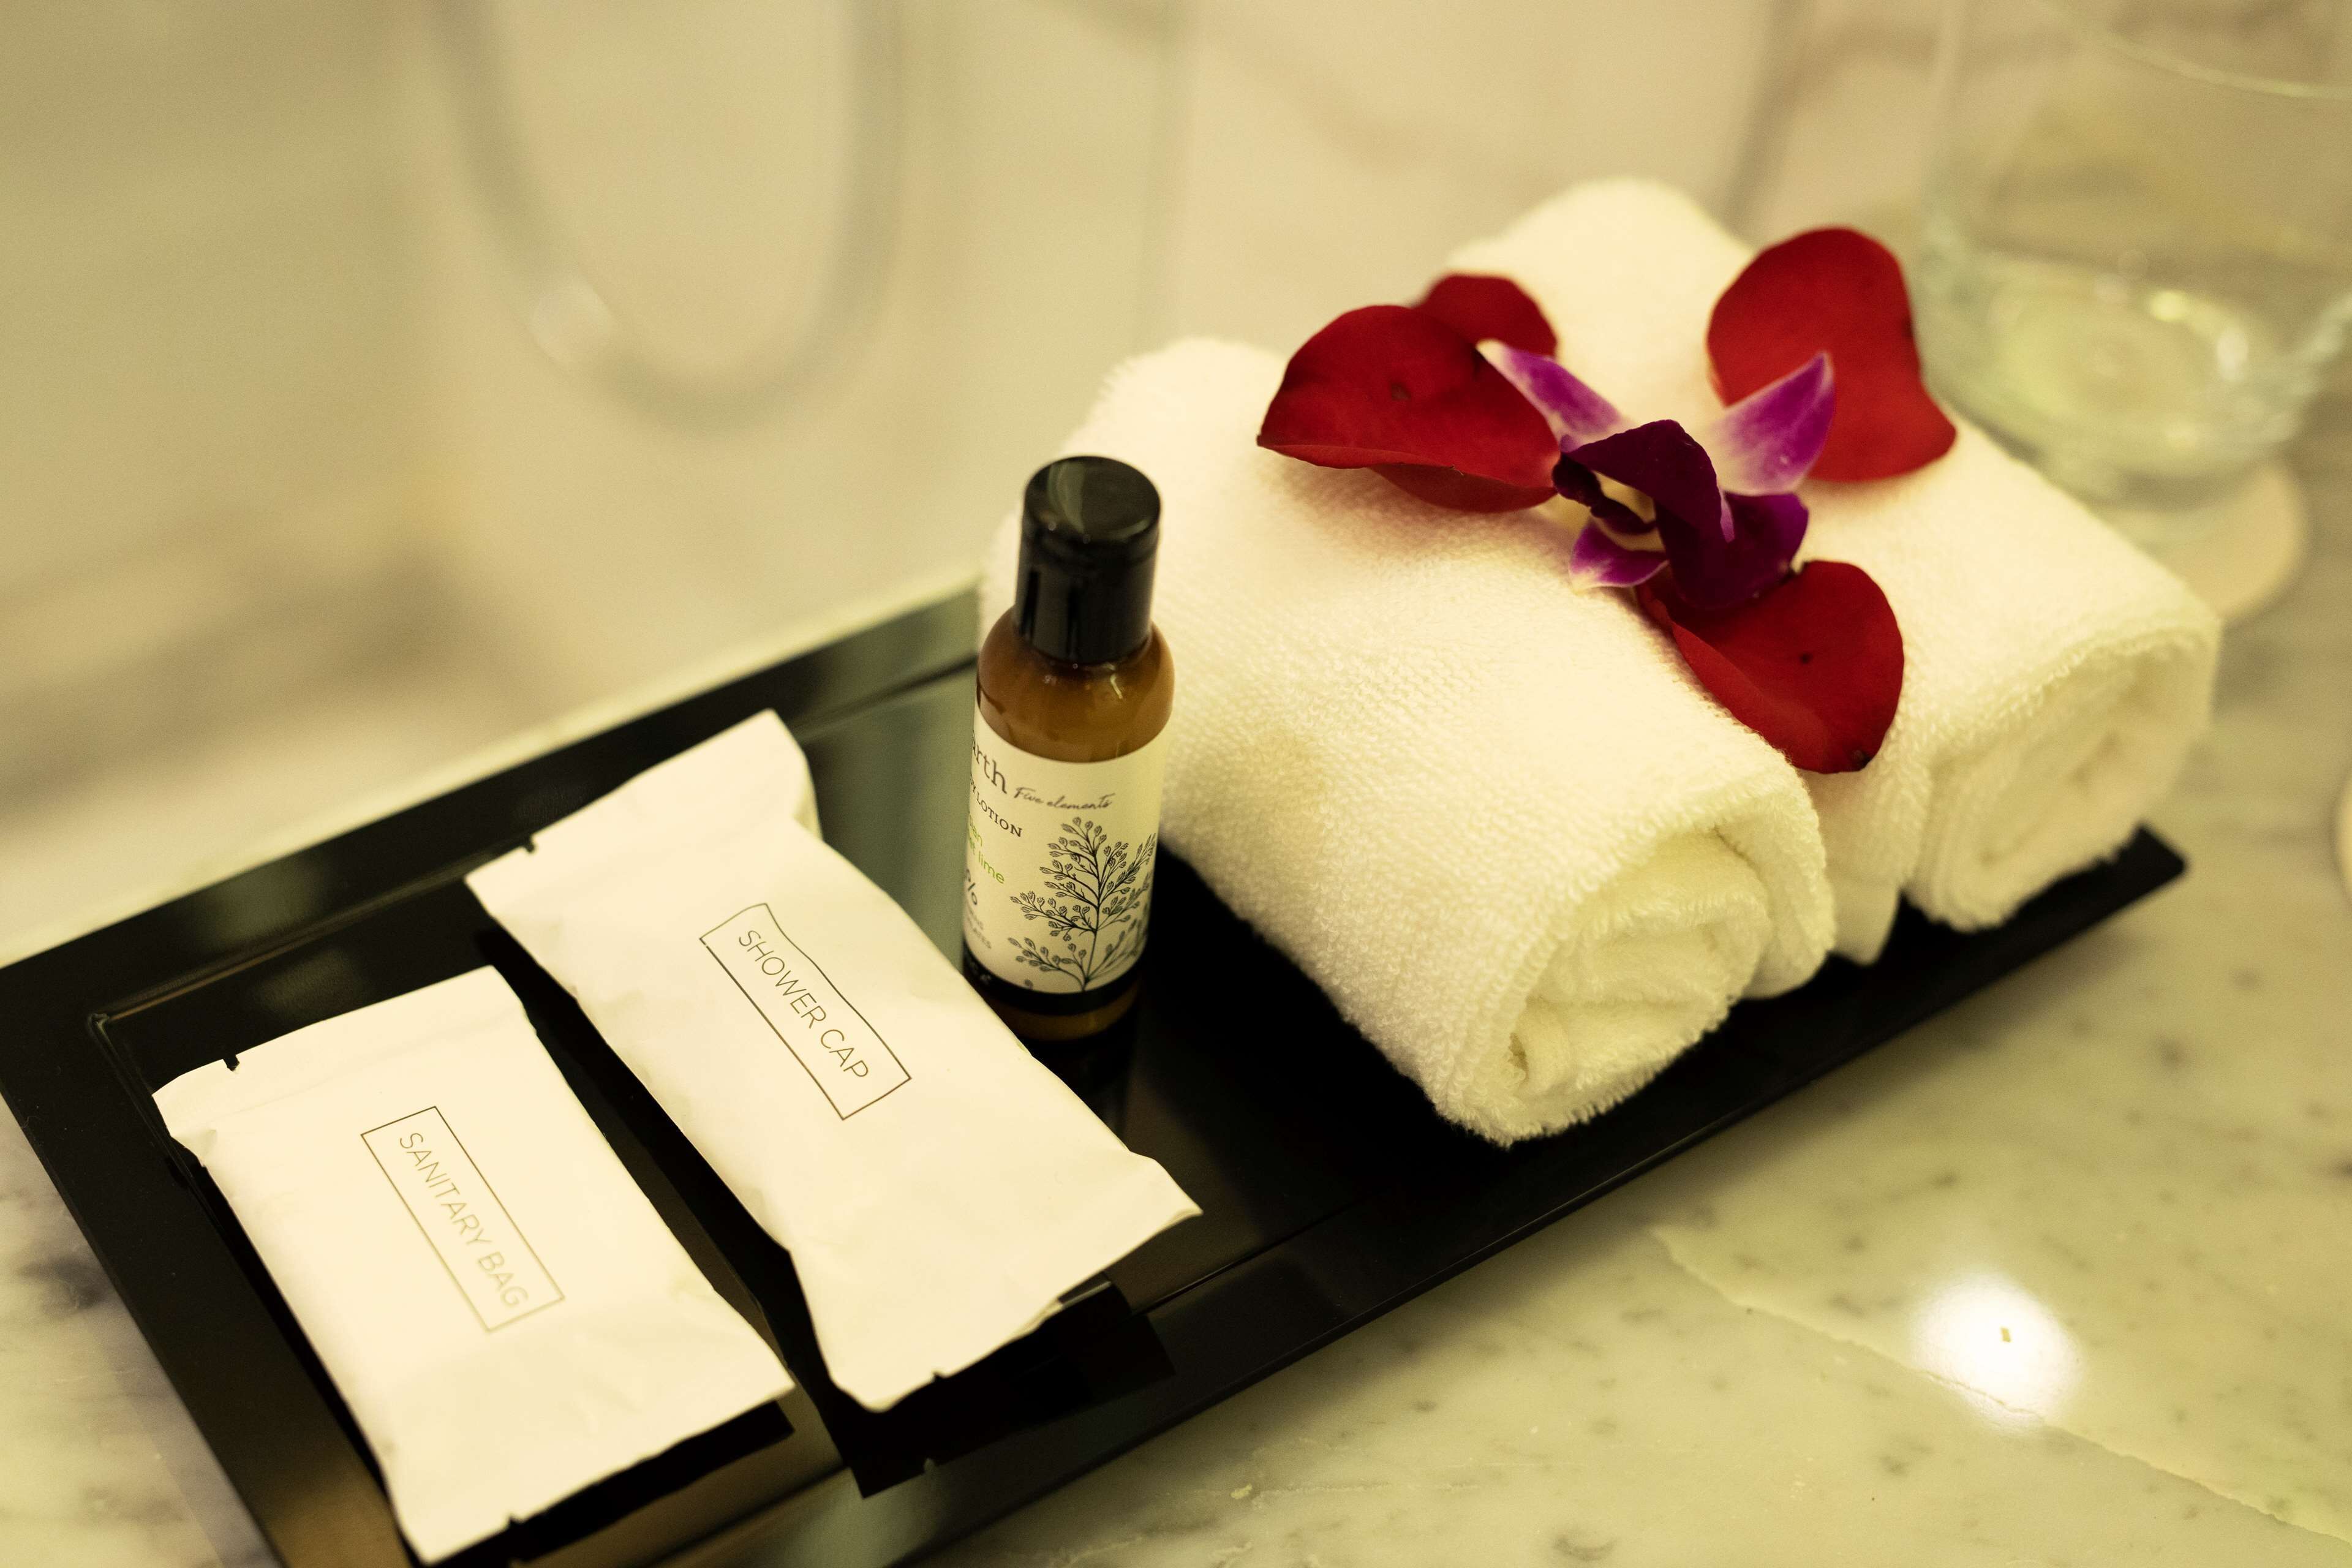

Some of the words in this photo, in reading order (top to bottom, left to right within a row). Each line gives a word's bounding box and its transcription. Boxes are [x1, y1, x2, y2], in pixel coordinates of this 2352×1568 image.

[976, 791, 1023, 838] LOTION
[1014, 786, 1044, 804] Five
[1046, 793, 1116, 810] elements
[978, 850, 1005, 884] lime
[738, 930, 827, 1030] SHOWER
[820, 1029, 869, 1078] CAP
[399, 1132, 492, 1246] SANITARY
[476, 1250, 529, 1310] BAG
